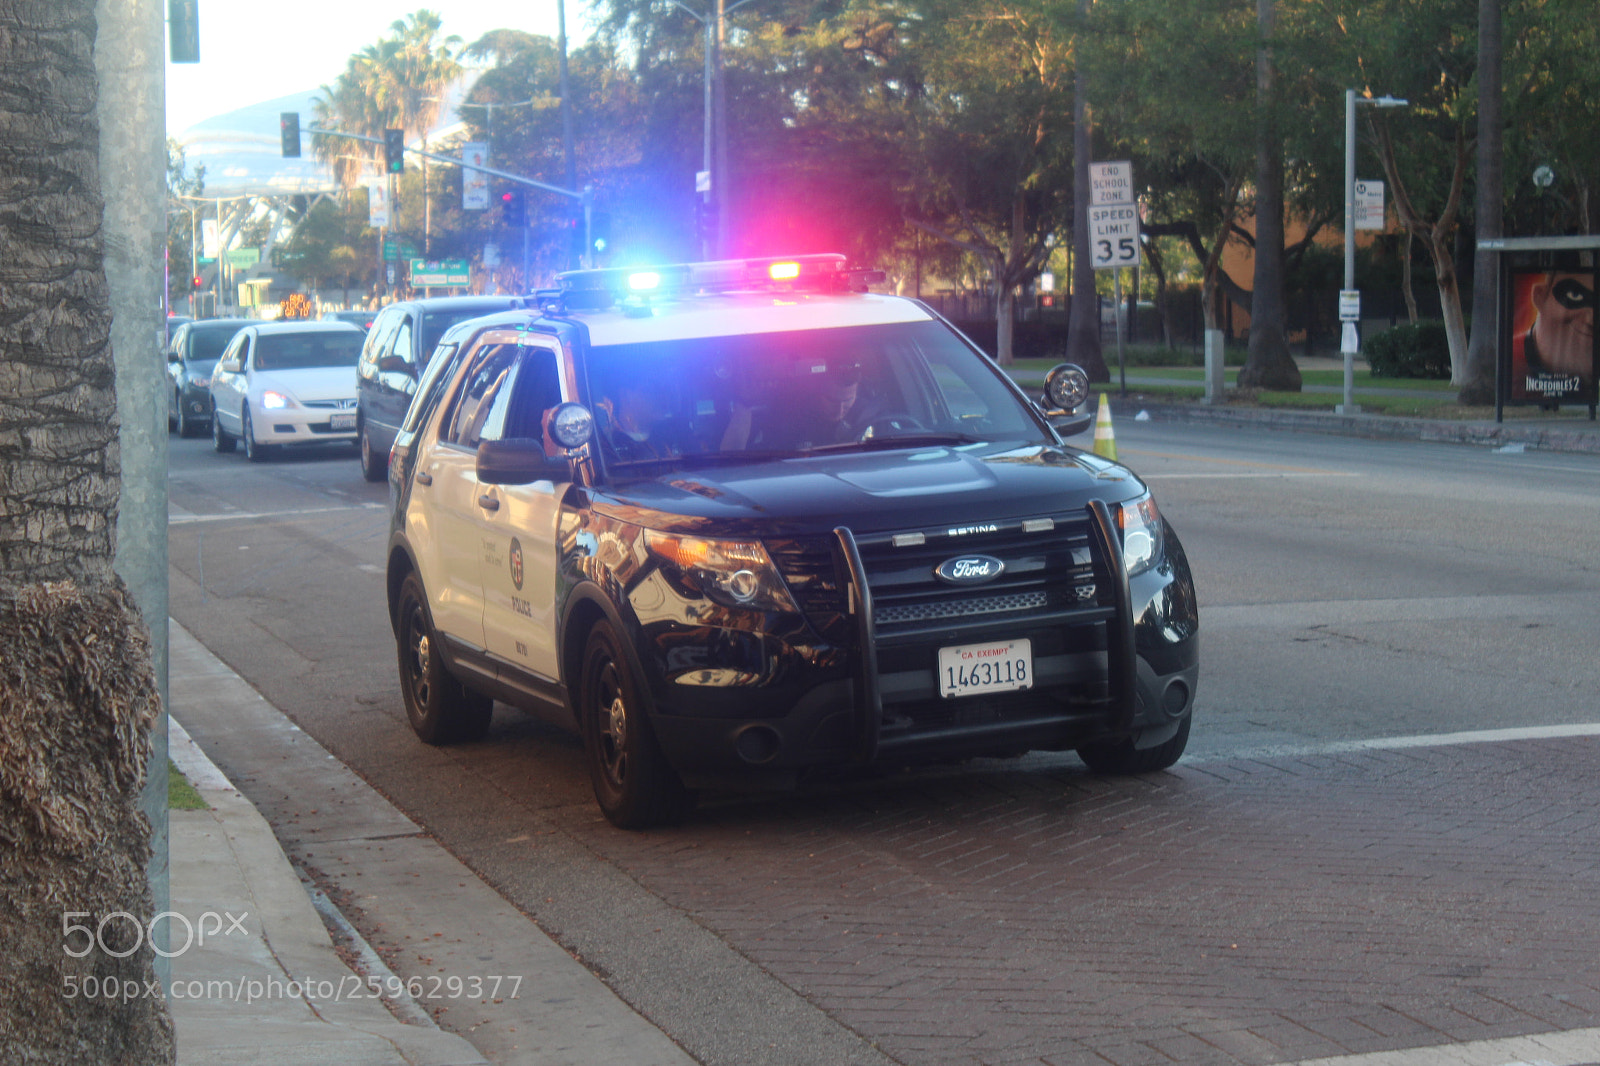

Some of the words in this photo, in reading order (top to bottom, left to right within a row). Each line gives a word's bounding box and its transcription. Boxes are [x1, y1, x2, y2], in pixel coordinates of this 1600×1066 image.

[1102, 167, 1119, 176] END
[1094, 178, 1128, 189] SCHOOL
[1101, 190, 1123, 201] ZONE
[1093, 209, 1134, 221] SPEED
[1098, 223, 1130, 235] LIMIT
[1097, 238, 1135, 263] 35
[1525, 376, 1573, 391] INCREDIBLES
[1573, 377, 1580, 391] 2
[952, 559, 990, 578] Ford
[511, 596, 532, 618] POLICE
[961, 652, 973, 660] CA
[977, 647, 1009, 659] EXEMPT
[947, 659, 1026, 689] 1463118
